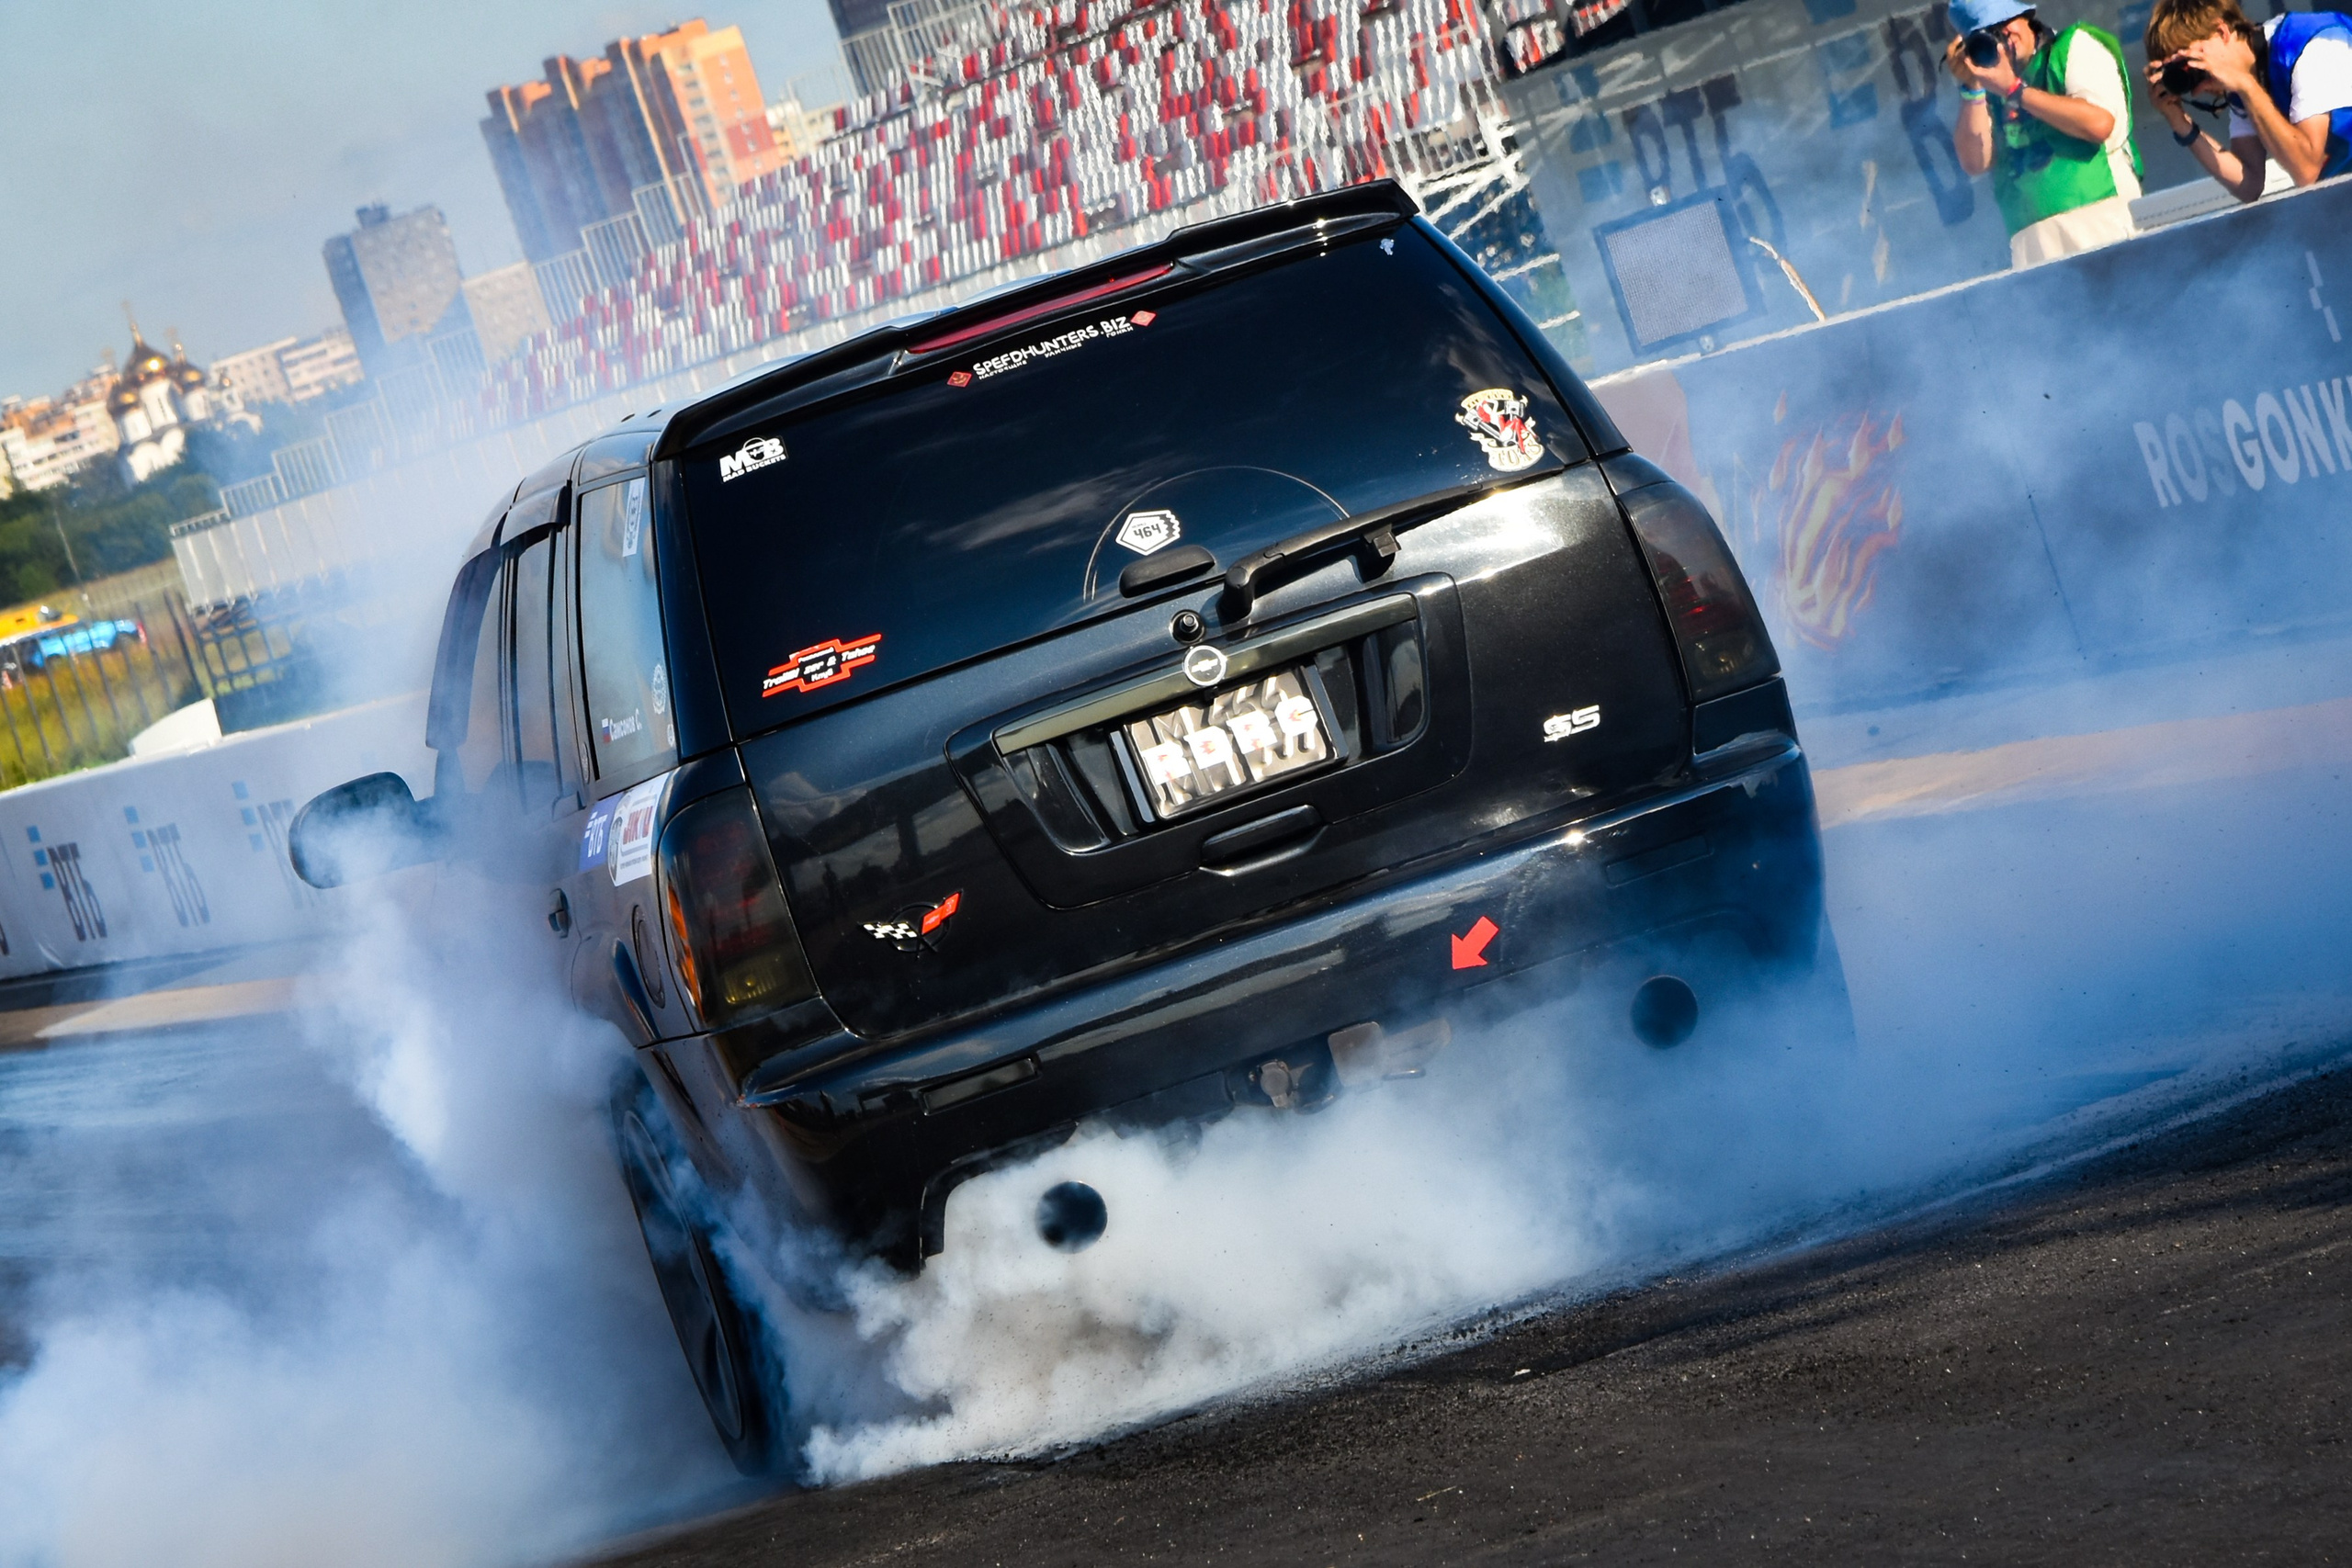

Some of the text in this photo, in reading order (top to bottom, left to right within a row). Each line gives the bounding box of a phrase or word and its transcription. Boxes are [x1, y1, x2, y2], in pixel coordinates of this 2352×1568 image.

[973, 316, 1131, 376] SPEEDHUNTERS.BIZ
[2132, 375, 2352, 508] ROSGONK
[723, 454, 786, 483] MAD BUCKETS
[1133, 524, 1162, 539] 464
[842, 644, 876, 661] Tahoe
[1544, 705, 1600, 743] SS
